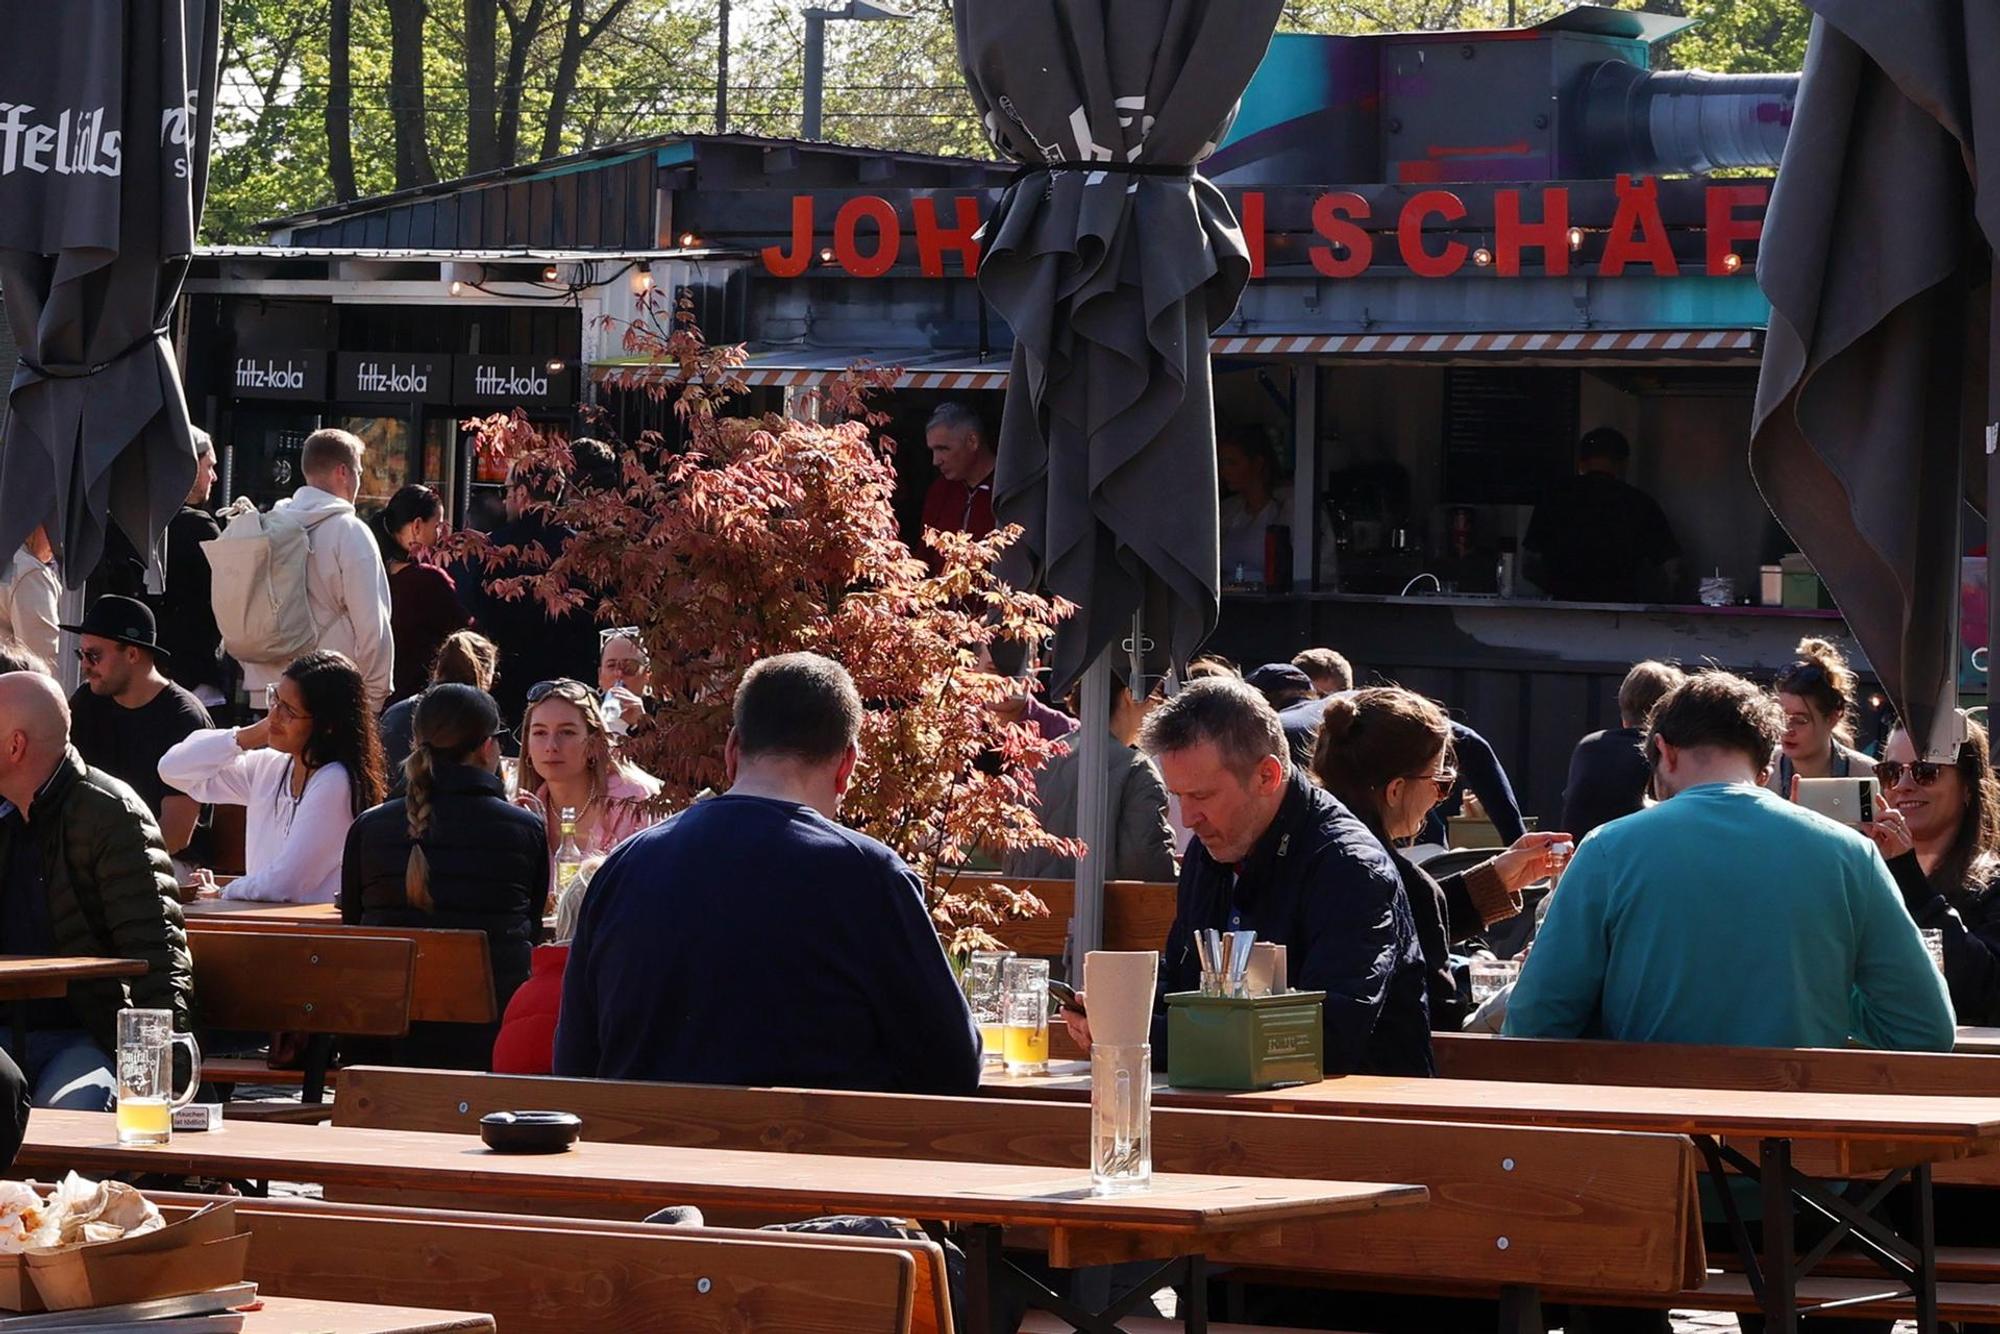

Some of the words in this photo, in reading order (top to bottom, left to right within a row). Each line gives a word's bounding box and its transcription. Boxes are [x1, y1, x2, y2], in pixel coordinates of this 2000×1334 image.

[236, 358, 304, 388] fritz-kola
[358, 362, 427, 393] fritz-kola
[475, 365, 548, 396] fritz-kola
